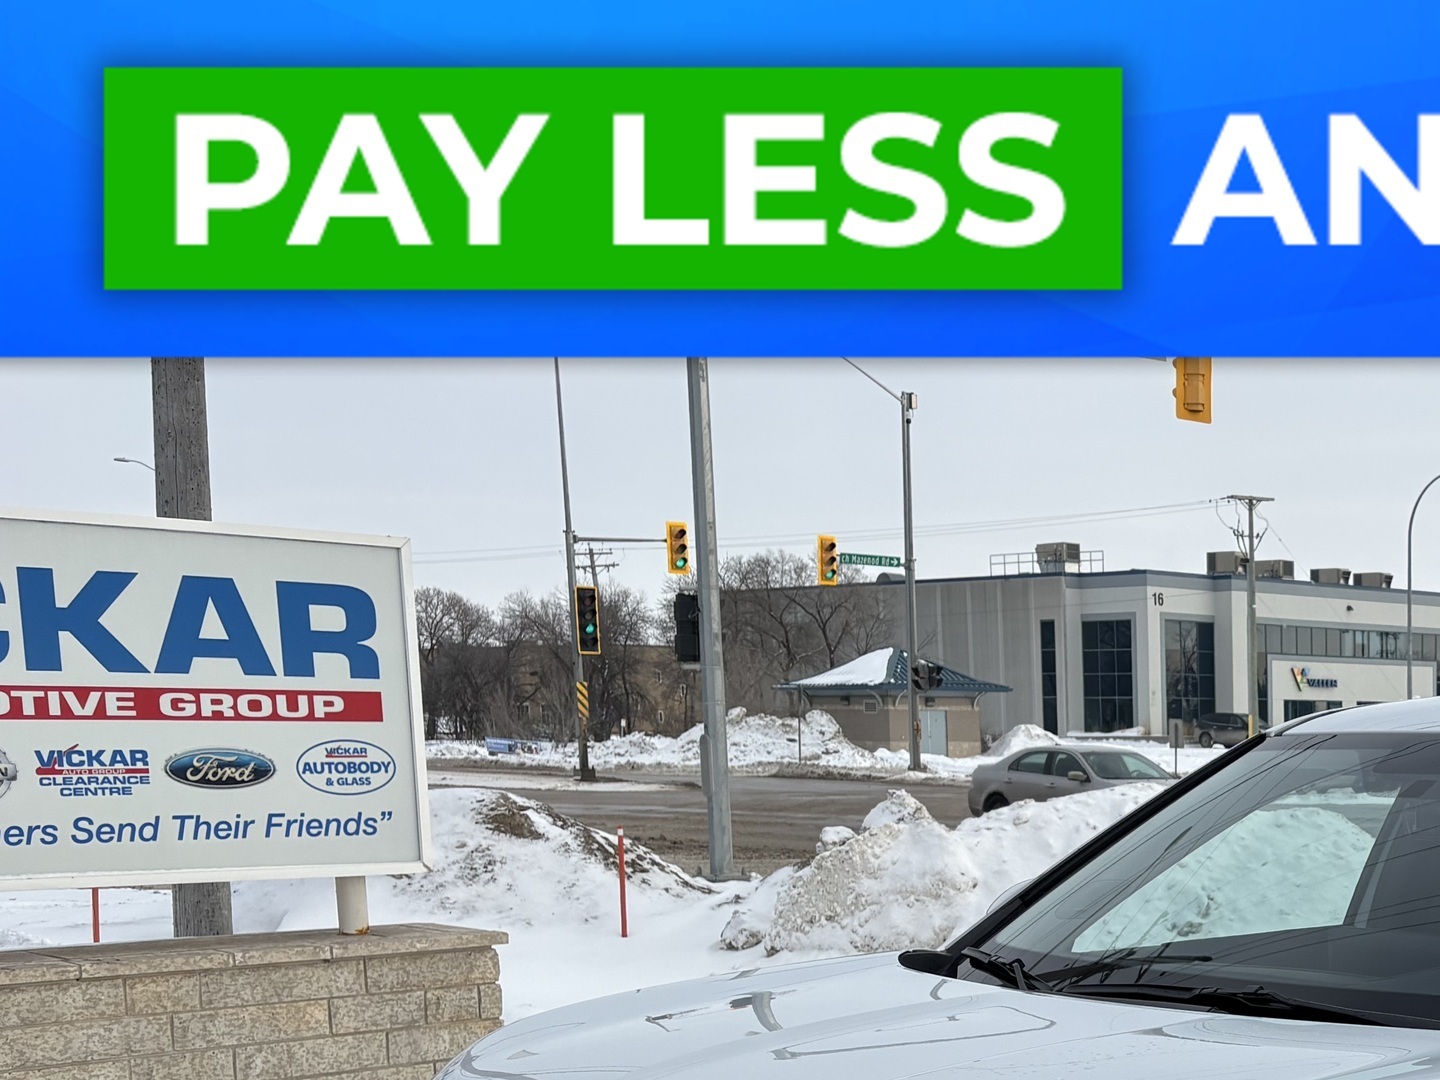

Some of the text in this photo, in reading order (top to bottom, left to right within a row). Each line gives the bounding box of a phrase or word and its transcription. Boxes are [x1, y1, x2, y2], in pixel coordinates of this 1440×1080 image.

[1151, 591, 1164, 606] 16
[0, 566, 381, 680] KAR
[159, 692, 345, 718] GROUP
[34, 748, 150, 768] VICKAR
[325, 746, 368, 756] VICKAR
[186, 753, 257, 783] Ford
[301, 761, 392, 775] AUTOBODY
[39, 775, 151, 787] CLEARANCE
[325, 776, 372, 787] & GLASS
[60, 786, 133, 797] CENTRE
[0, 824, 59, 847] ers
[71, 815, 160, 844] Send
[172, 813, 255, 841] Their
